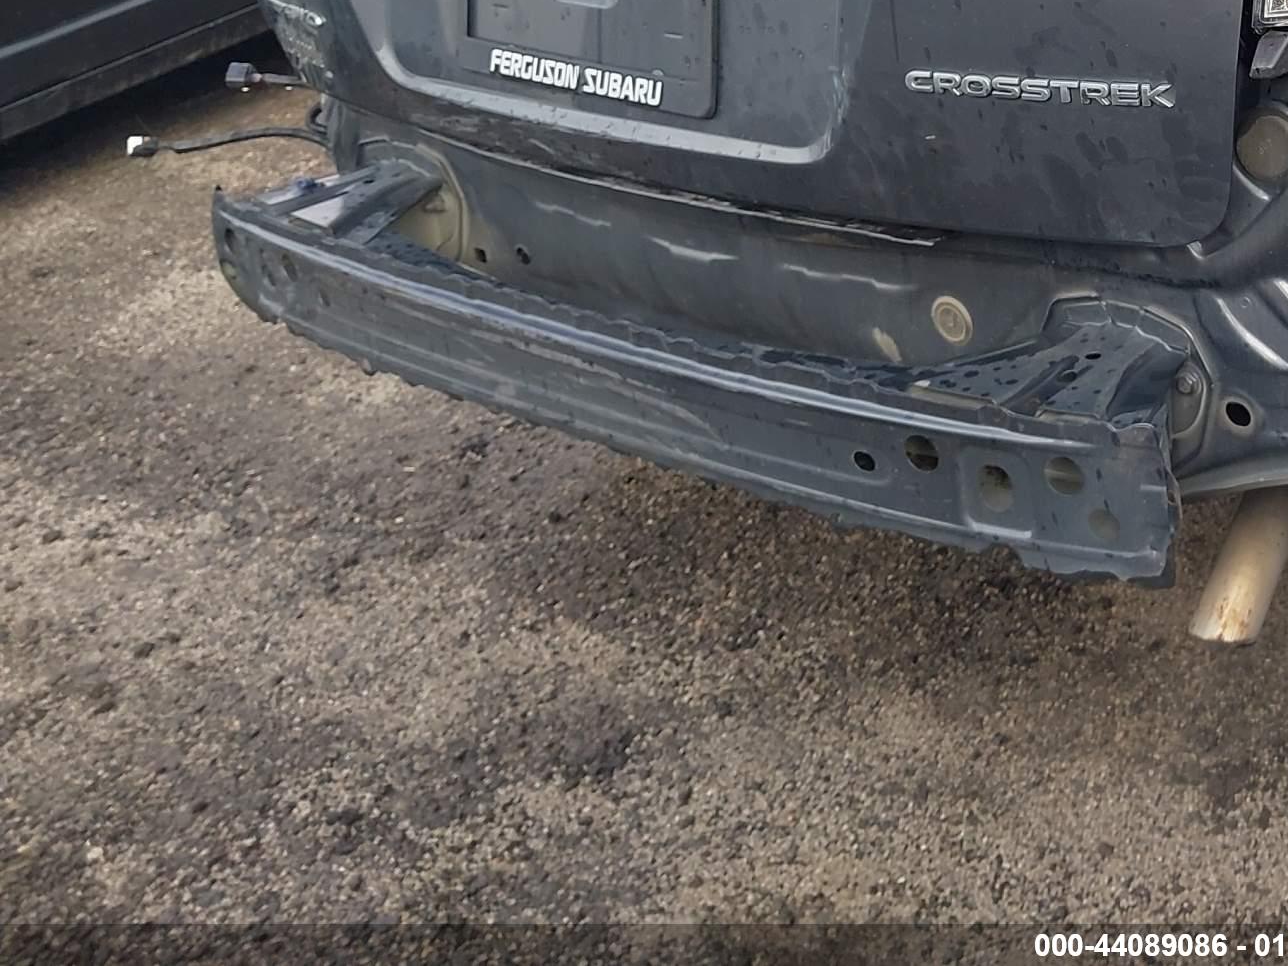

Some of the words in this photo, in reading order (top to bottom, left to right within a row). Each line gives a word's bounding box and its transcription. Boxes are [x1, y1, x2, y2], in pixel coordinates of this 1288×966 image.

[489, 48, 580, 90] FERGUSON
[582, 67, 664, 107] SUBARU
[904, 69, 1176, 109] CROSSTREK
